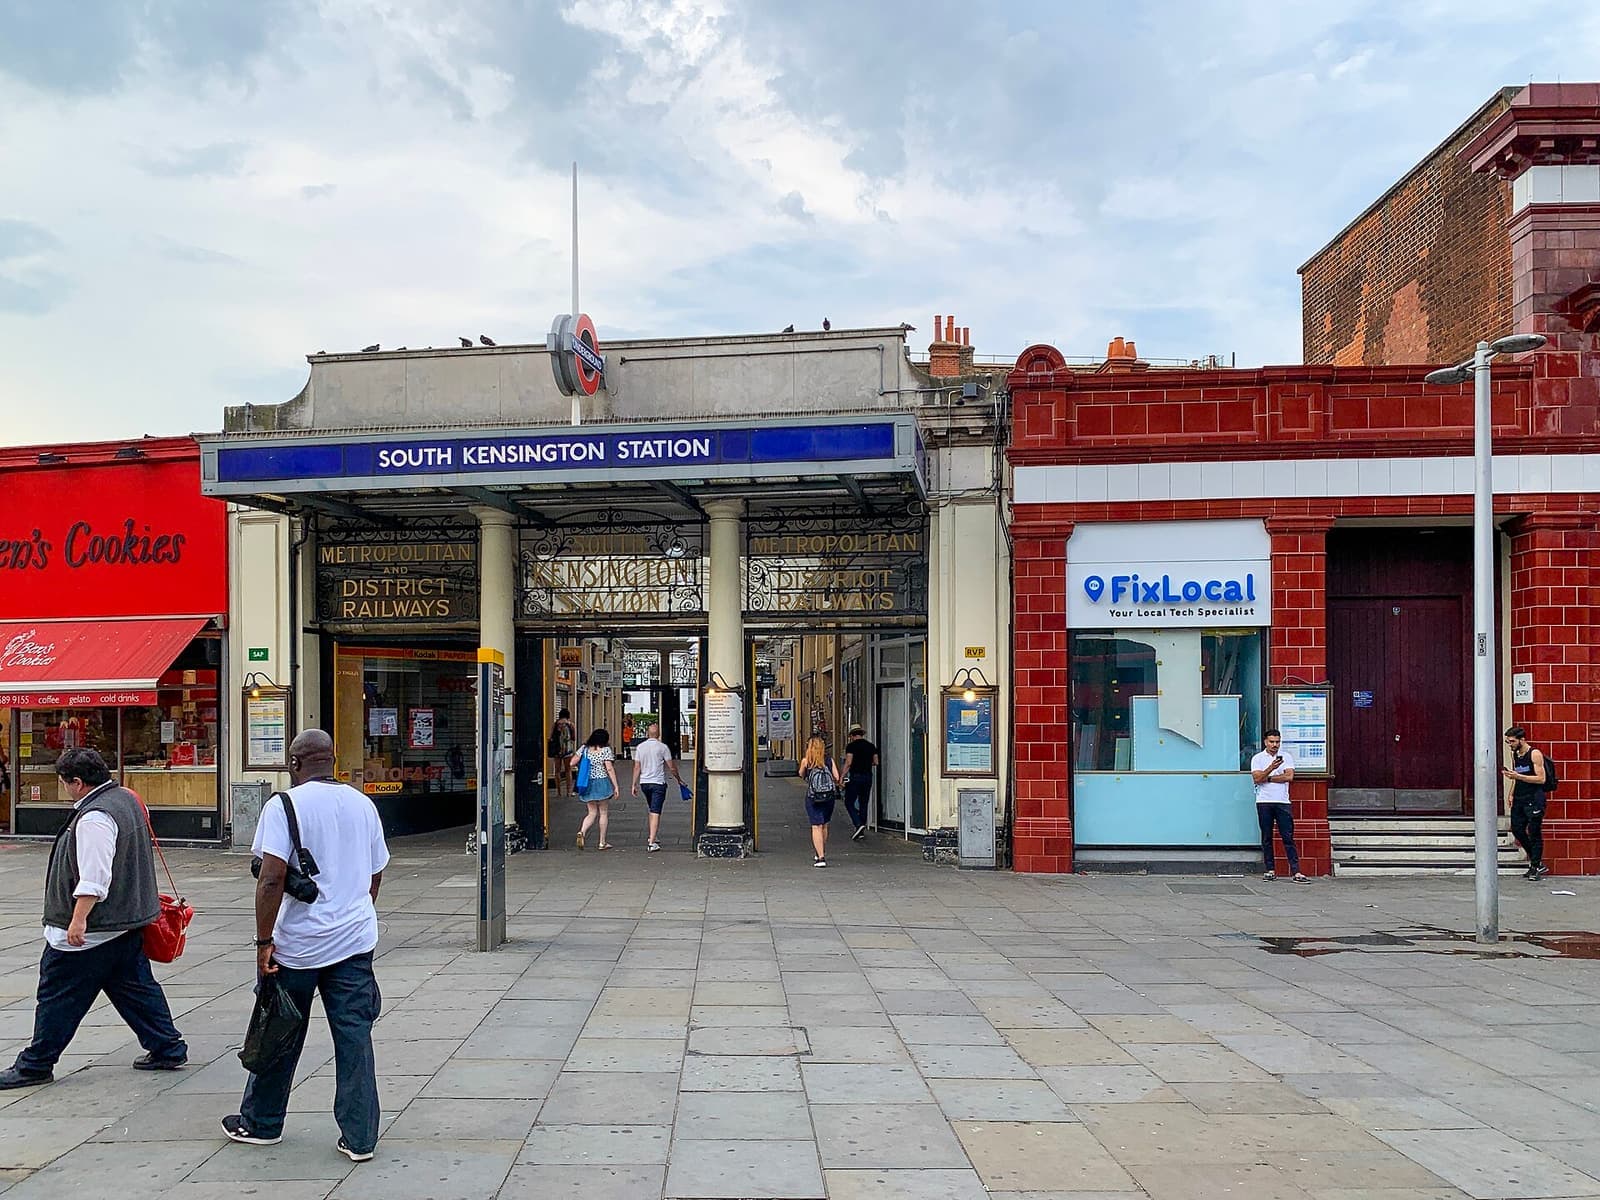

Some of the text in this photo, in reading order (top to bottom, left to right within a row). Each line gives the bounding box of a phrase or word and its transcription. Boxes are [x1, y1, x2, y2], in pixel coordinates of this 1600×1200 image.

[378, 438, 710, 468] SOUTH KENSINGTON STATION
[65, 518, 186, 568] Cookies
[574, 534, 645, 554] SOUTH
[752, 532, 917, 554] METROPOLITAN
[321, 543, 471, 563] METROPOLITAN
[383, 566, 408, 575] AND
[532, 559, 688, 588] KENSINGTON
[777, 570, 893, 589] DISTRICT
[343, 577, 449, 597] DISTRICT
[1111, 573, 1256, 604] FixLocal
[343, 599, 450, 618] RAILWAYS
[561, 591, 660, 613] STATION
[778, 592, 895, 611] RAILWAYS
[1109, 607, 1255, 618] Your Local Tech Specialist
[7, 653, 57, 666] Cookies
[414, 650, 436, 659] Kodak
[12, 695, 29, 704] 9155
[38, 695, 60, 704] coffee
[69, 695, 91, 705] gelato
[100, 693, 140, 703] cold drinks
[375, 783, 401, 792] Kodak
